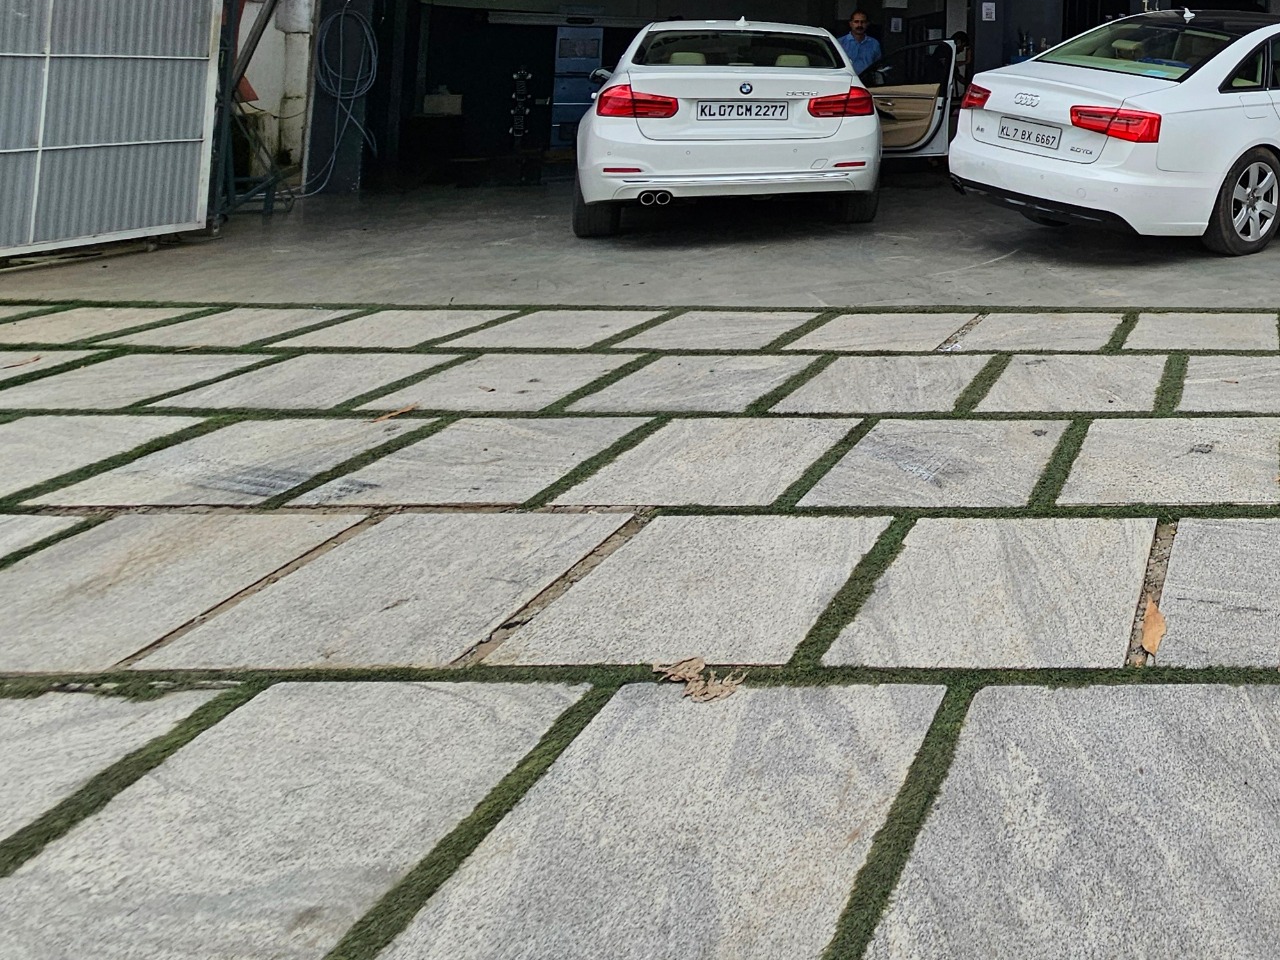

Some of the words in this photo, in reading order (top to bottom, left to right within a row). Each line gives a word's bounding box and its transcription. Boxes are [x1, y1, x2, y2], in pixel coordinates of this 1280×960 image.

[700, 105, 716, 117] KL
[718, 105, 735, 117] 07
[736, 105, 753, 117] CM
[754, 105, 786, 117] 2277
[1000, 125, 1011, 137] KL
[1012, 128, 1019, 138] 7
[1020, 131, 1032, 141] BX
[1035, 134, 1057, 146] 6667
